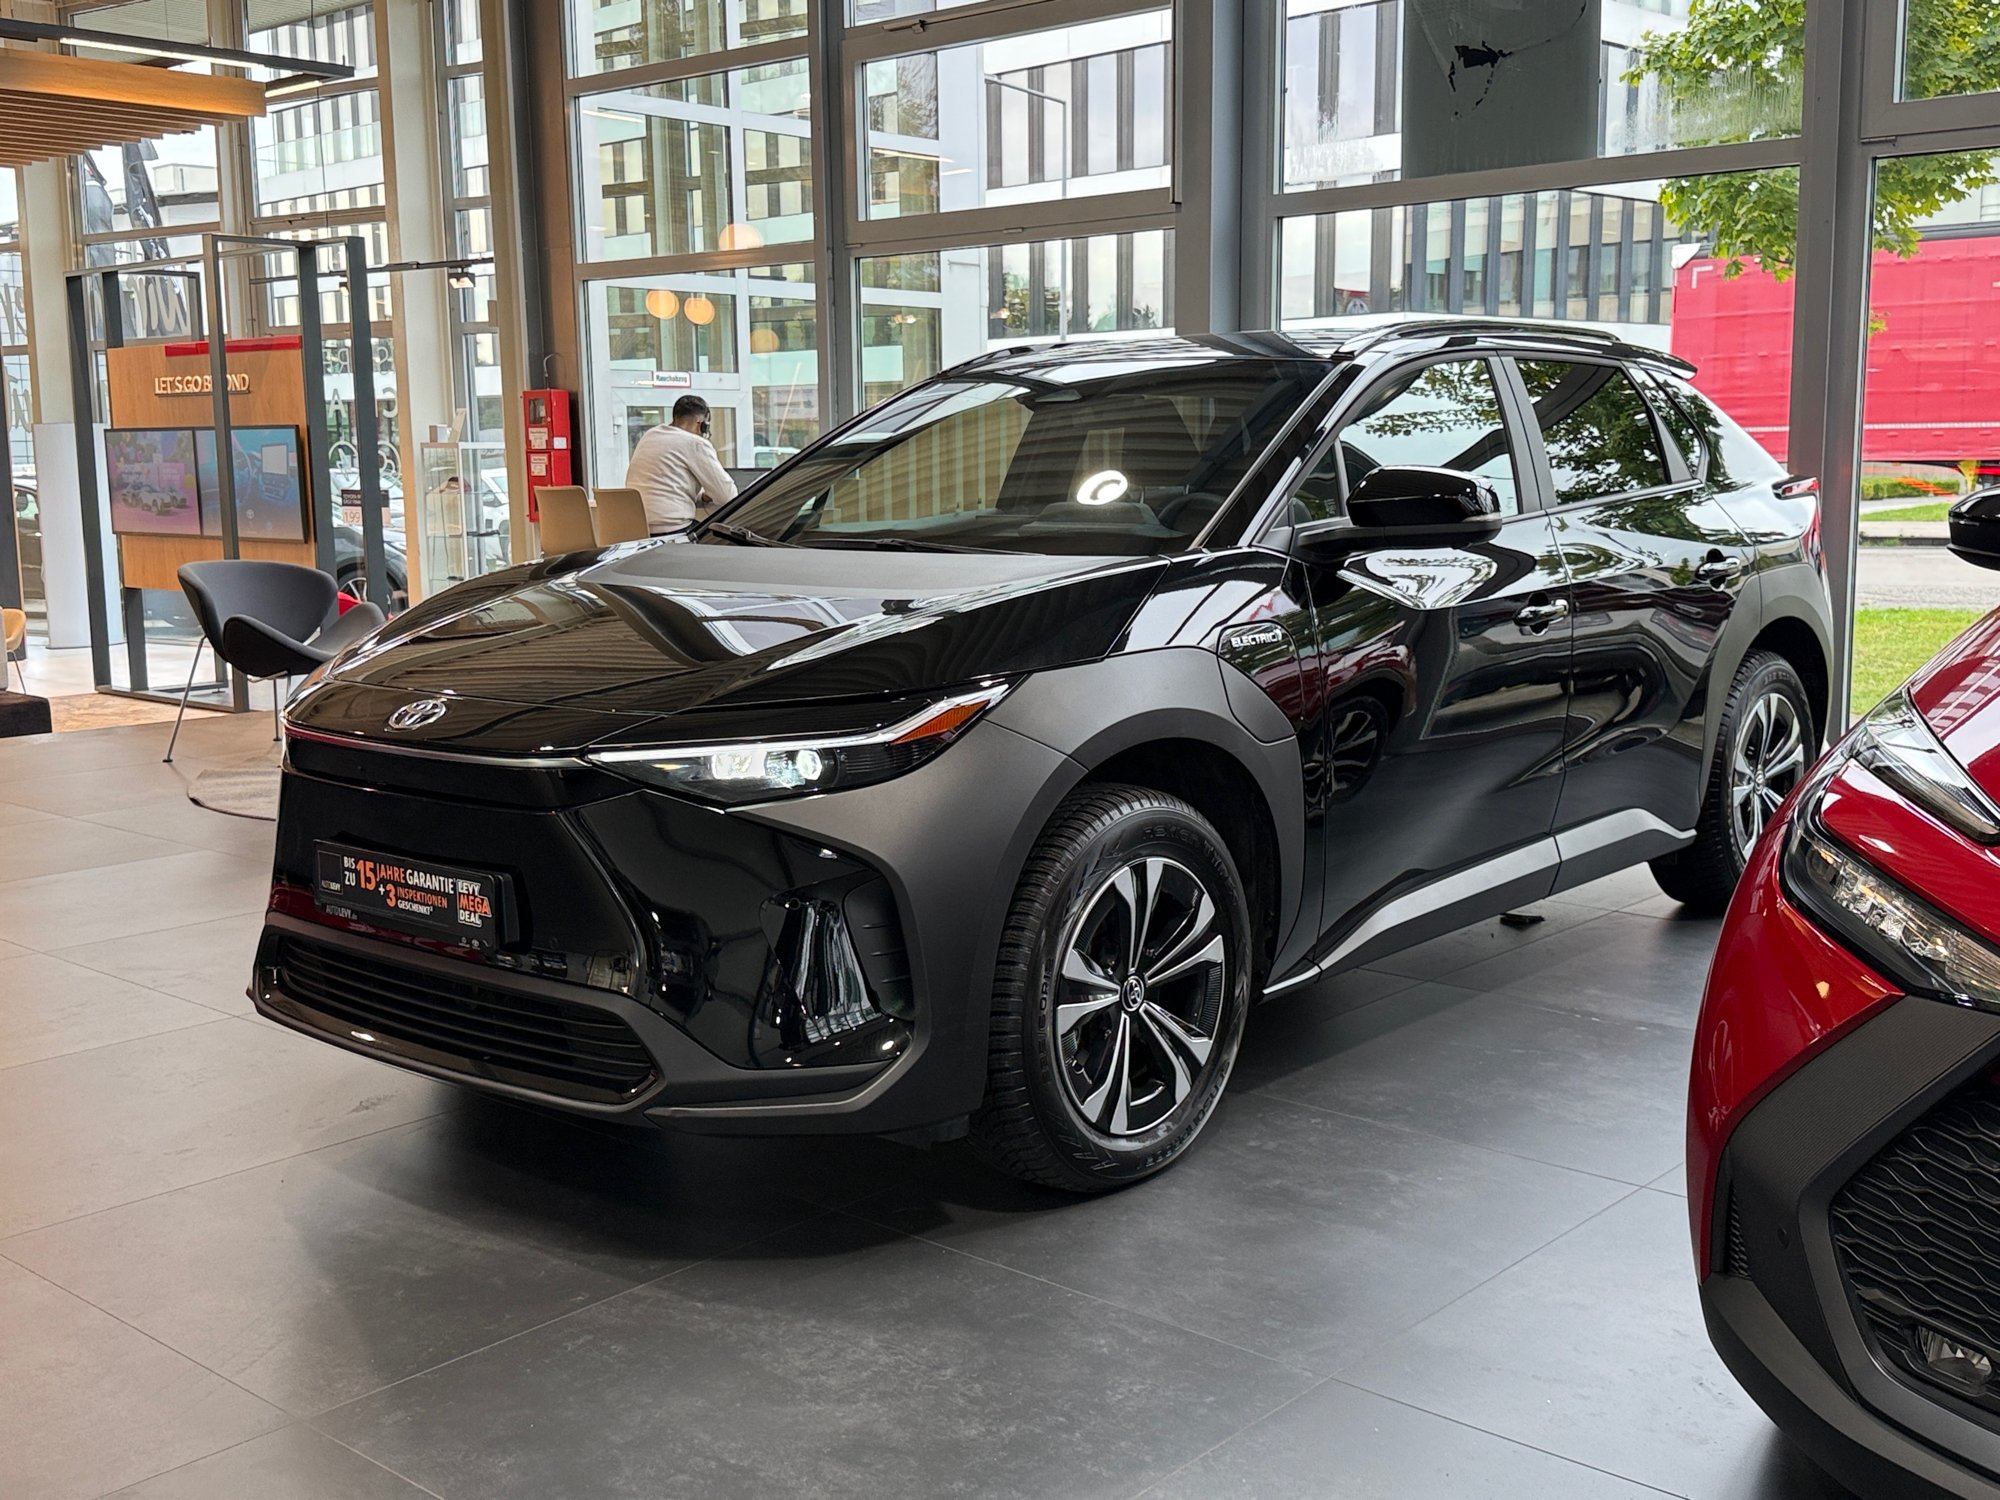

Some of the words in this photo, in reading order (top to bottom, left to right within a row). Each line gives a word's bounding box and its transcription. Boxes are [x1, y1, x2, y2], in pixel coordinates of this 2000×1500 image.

[183, 375, 202, 393] GO
[1231, 632, 1277, 648] ELECTRIC
[343, 856, 356, 869] BIS
[344, 871, 356, 886] ZU
[356, 860, 376, 891] 15
[376, 863, 406, 883] JAHRE
[458, 880, 480, 896] LEVY
[397, 887, 448, 909] INSPEKTIONEN
[460, 894, 490, 914] MEGA
[460, 910, 481, 924] DEAL
